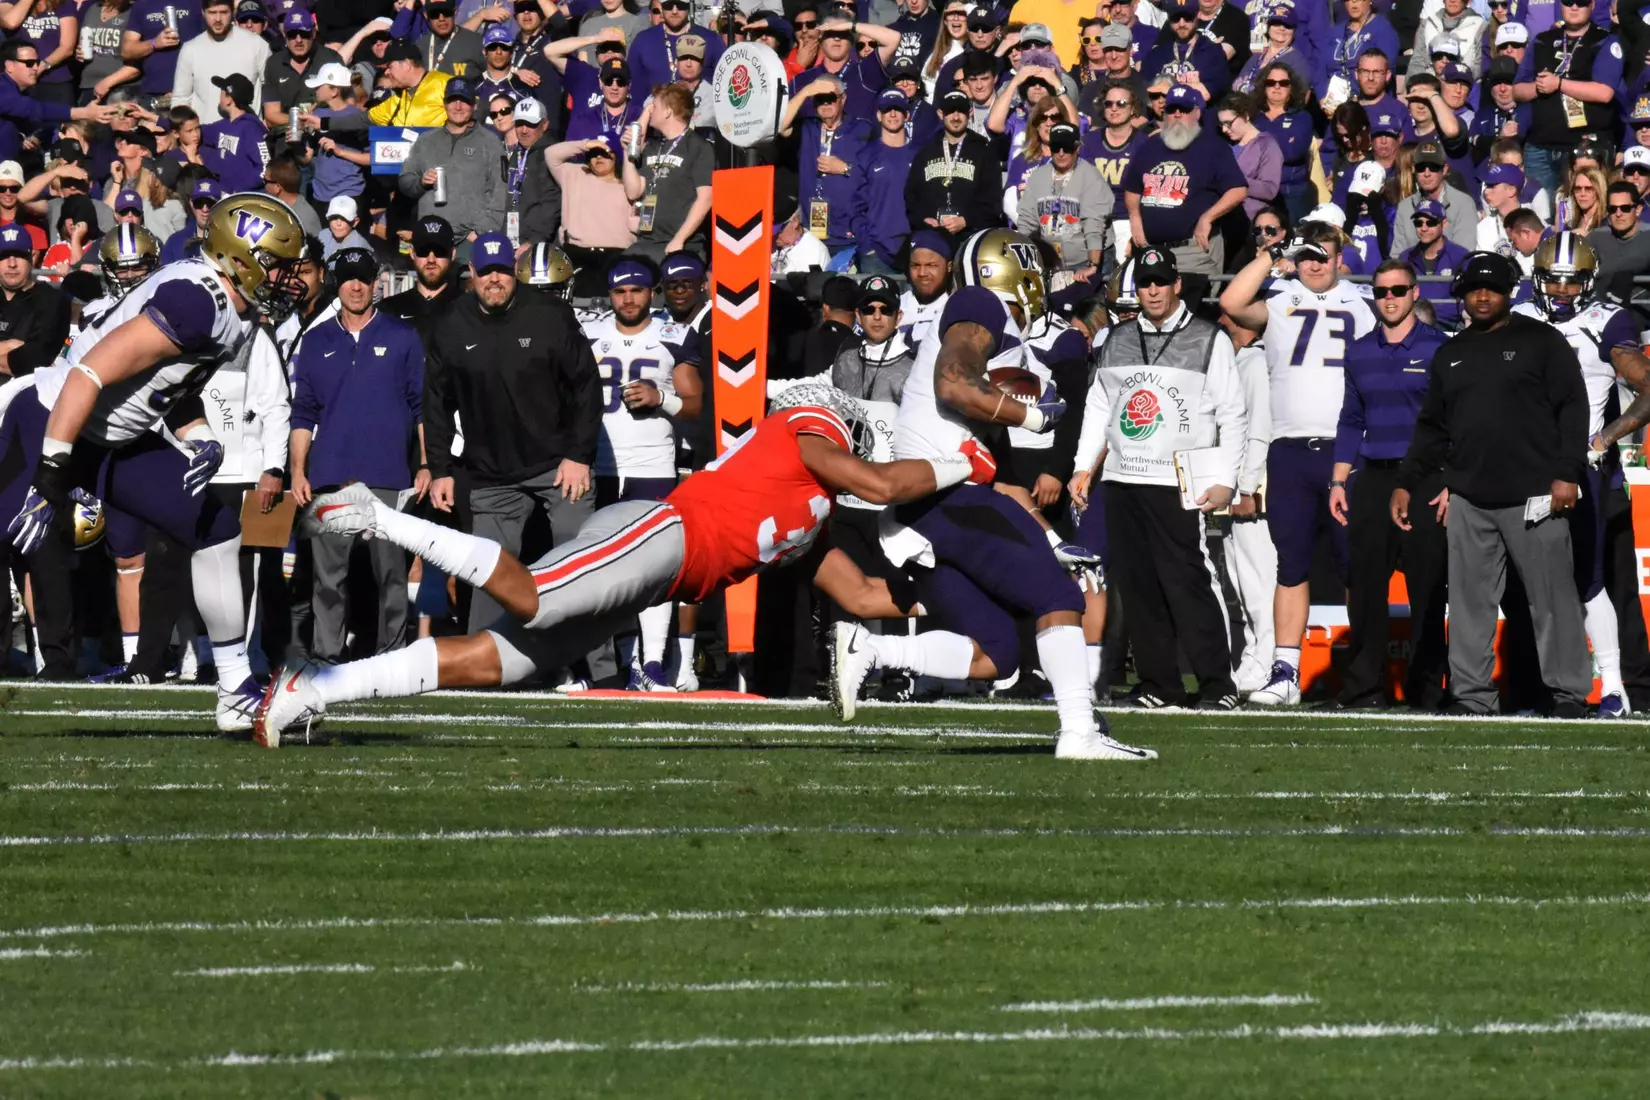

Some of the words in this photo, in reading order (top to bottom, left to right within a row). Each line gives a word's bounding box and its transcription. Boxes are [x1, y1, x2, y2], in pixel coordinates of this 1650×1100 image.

[452, 63, 467, 76] W
[714, 64, 726, 103] ROSE
[725, 49, 751, 65] BOWL
[751, 56, 768, 95] GAME
[1172, 87, 1187, 98] W
[520, 103, 532, 112] W
[1632, 150, 1643, 159] W
[1094, 157, 1129, 185] W
[1360, 172, 1371, 181] W
[235, 209, 274, 246] W
[425, 222, 442, 233] W
[2, 229, 19, 242] W
[484, 241, 501, 255] W
[345, 252, 361, 263] W
[1009, 243, 1039, 271] W
[981, 268, 992, 277] RJ
[518, 338, 531, 347] W
[1287, 308, 1356, 367] 73
[374, 347, 387, 356] W
[1502, 351, 1516, 360] W
[1125, 371, 1165, 390] BOWL
[1167, 386, 1190, 433] GAME
[209, 388, 234, 432] GAME
[1120, 463, 1148, 473] Mutual
